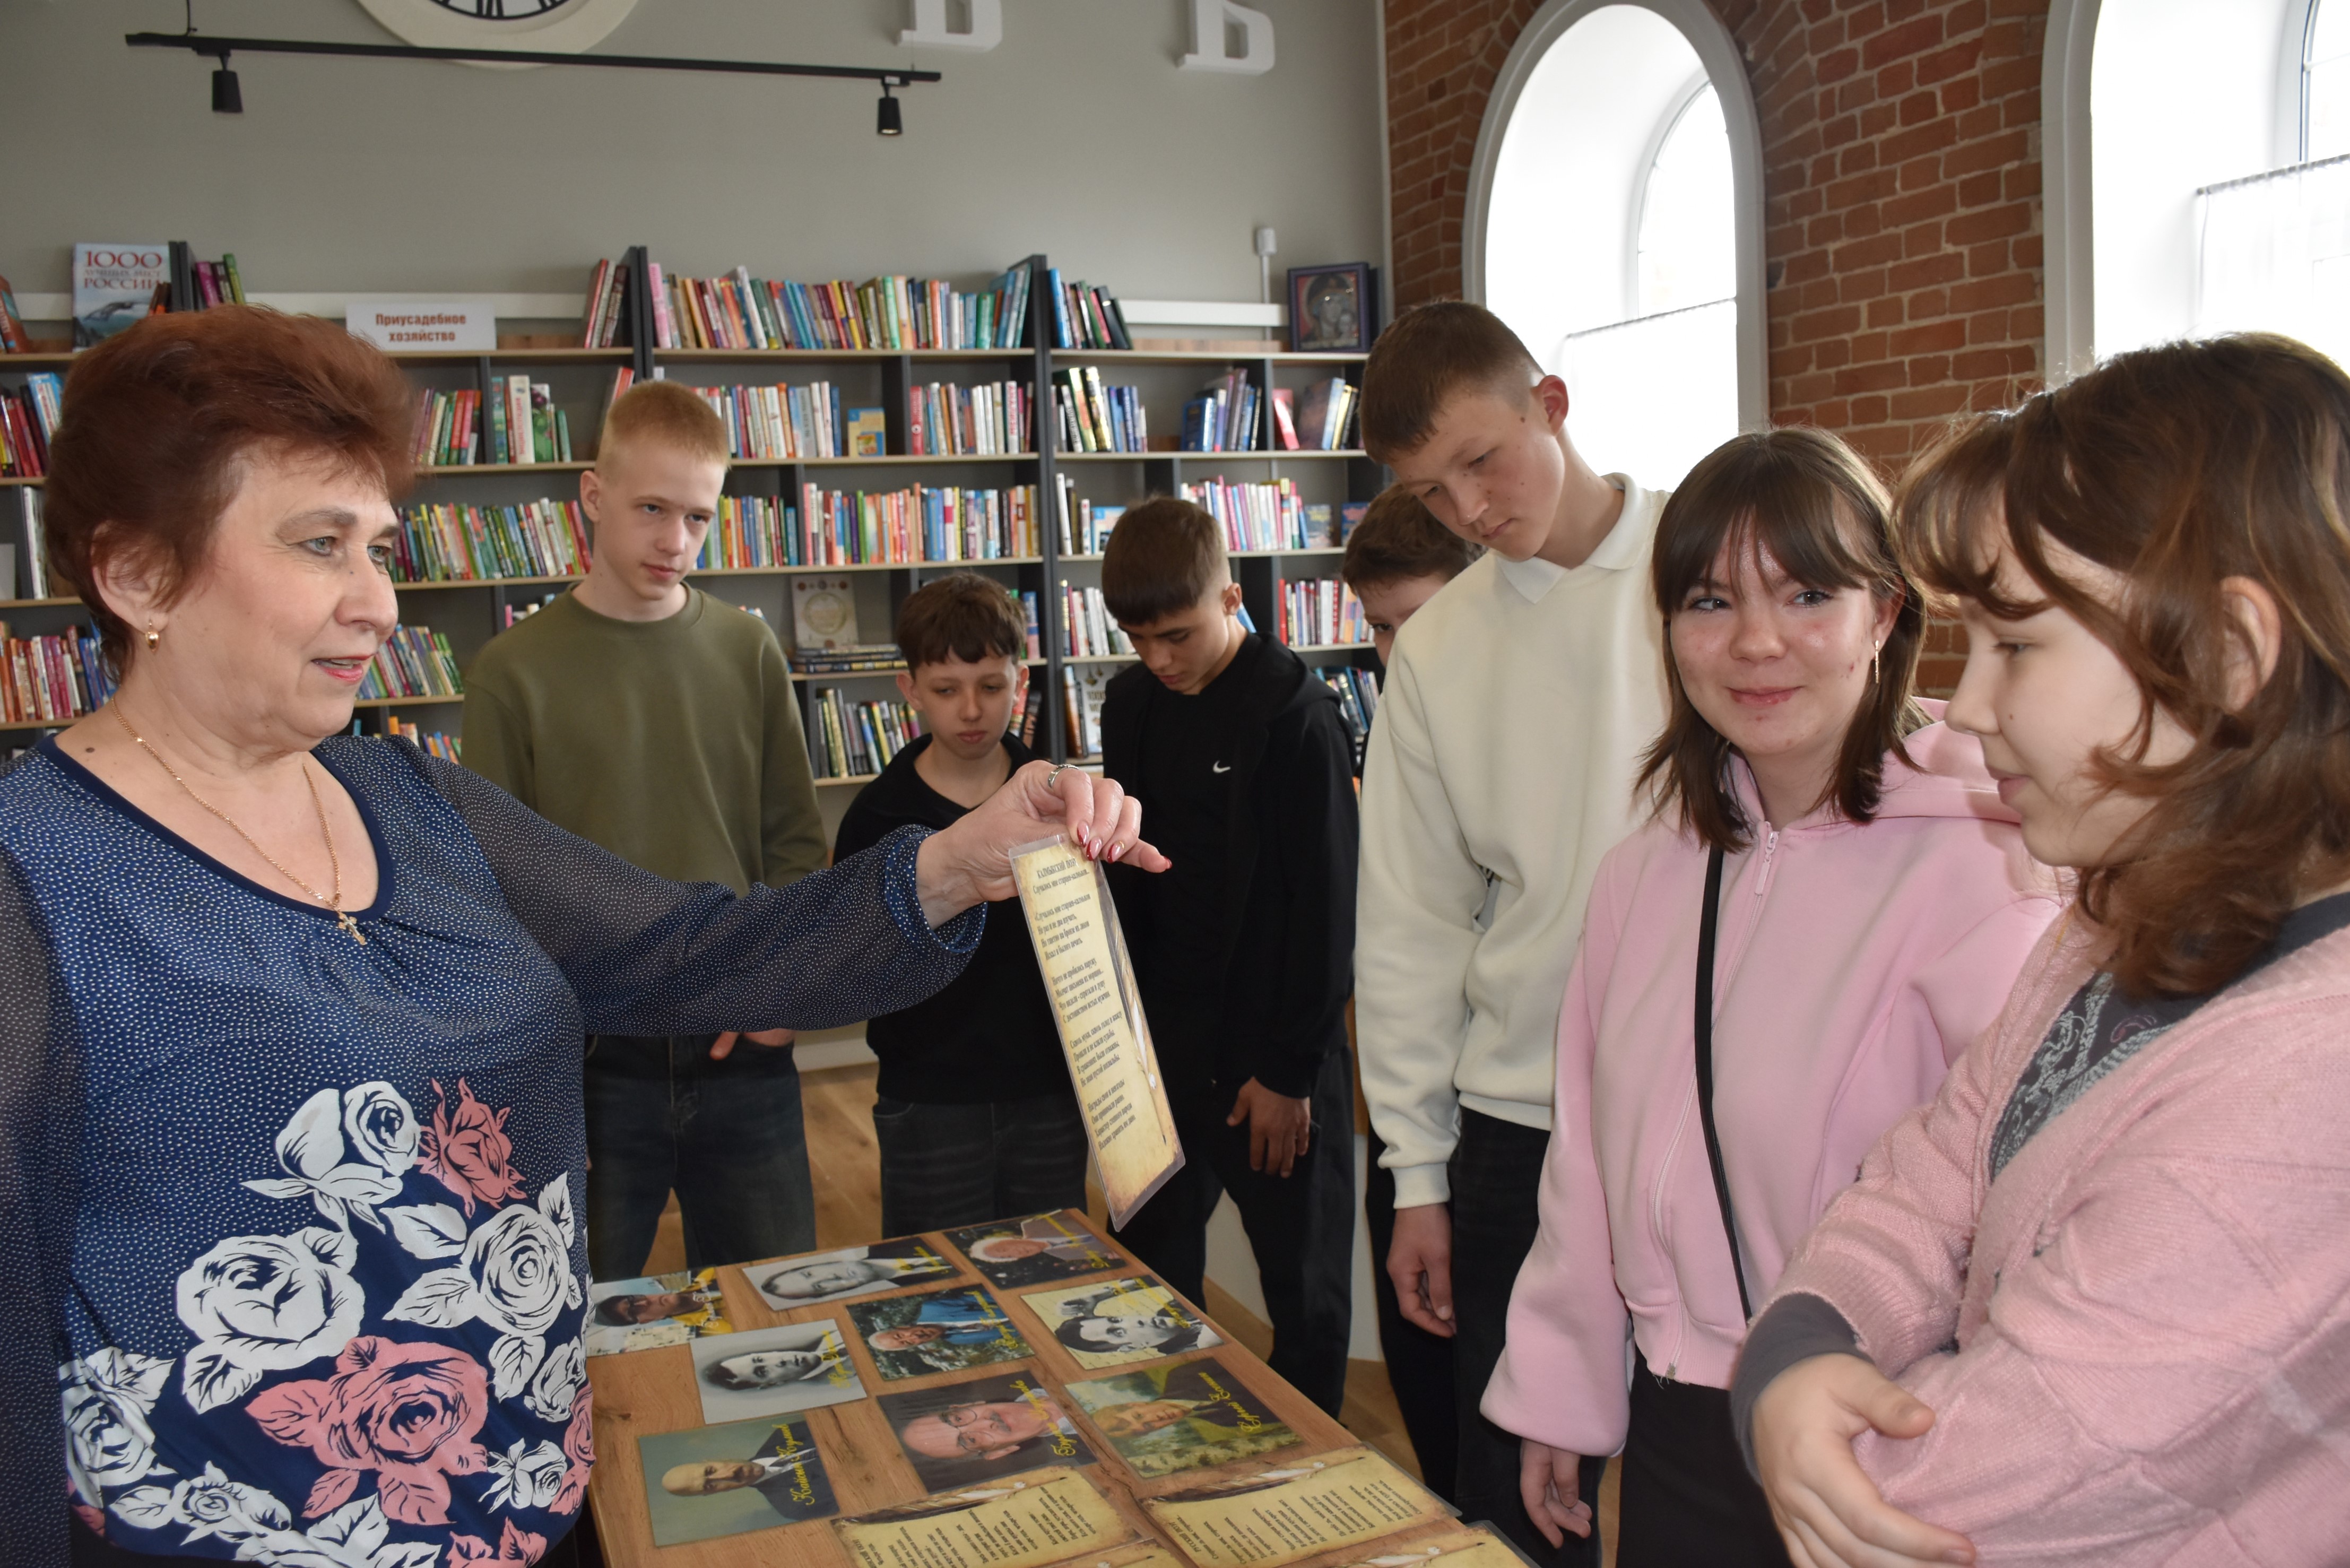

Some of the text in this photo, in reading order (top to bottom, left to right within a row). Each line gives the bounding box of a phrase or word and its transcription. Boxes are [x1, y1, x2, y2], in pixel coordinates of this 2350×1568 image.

[86, 251, 162, 268] 1000
[376, 313, 466, 326] Приусадебное
[389, 330, 455, 341] хозяйство
[1224, 1401, 1261, 1432] Сергей
[790, 1462, 815, 1505] Кайсын
